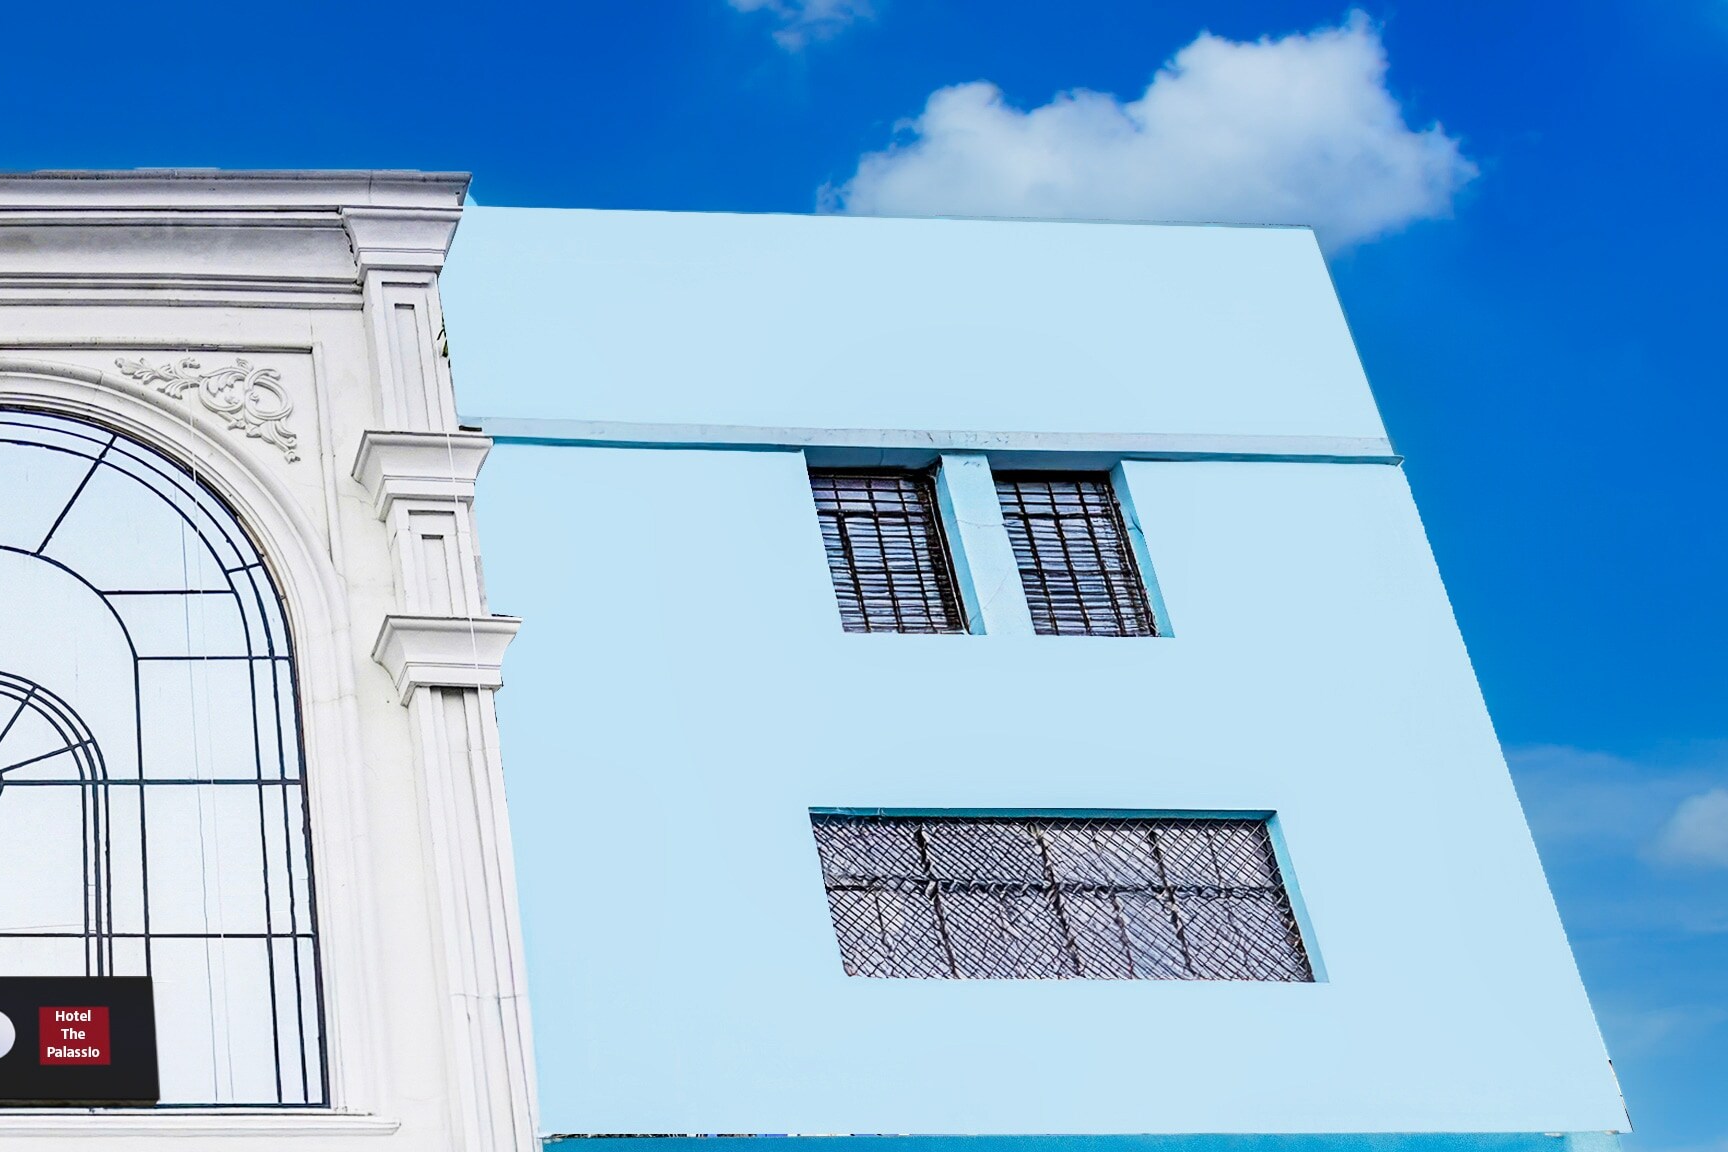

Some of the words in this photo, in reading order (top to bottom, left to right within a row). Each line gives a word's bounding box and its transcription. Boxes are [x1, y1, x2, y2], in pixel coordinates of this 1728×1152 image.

[55, 1009, 92, 1022] Hotel
[60, 1027, 86, 1040] The
[47, 1045, 100, 1058] Palassio
